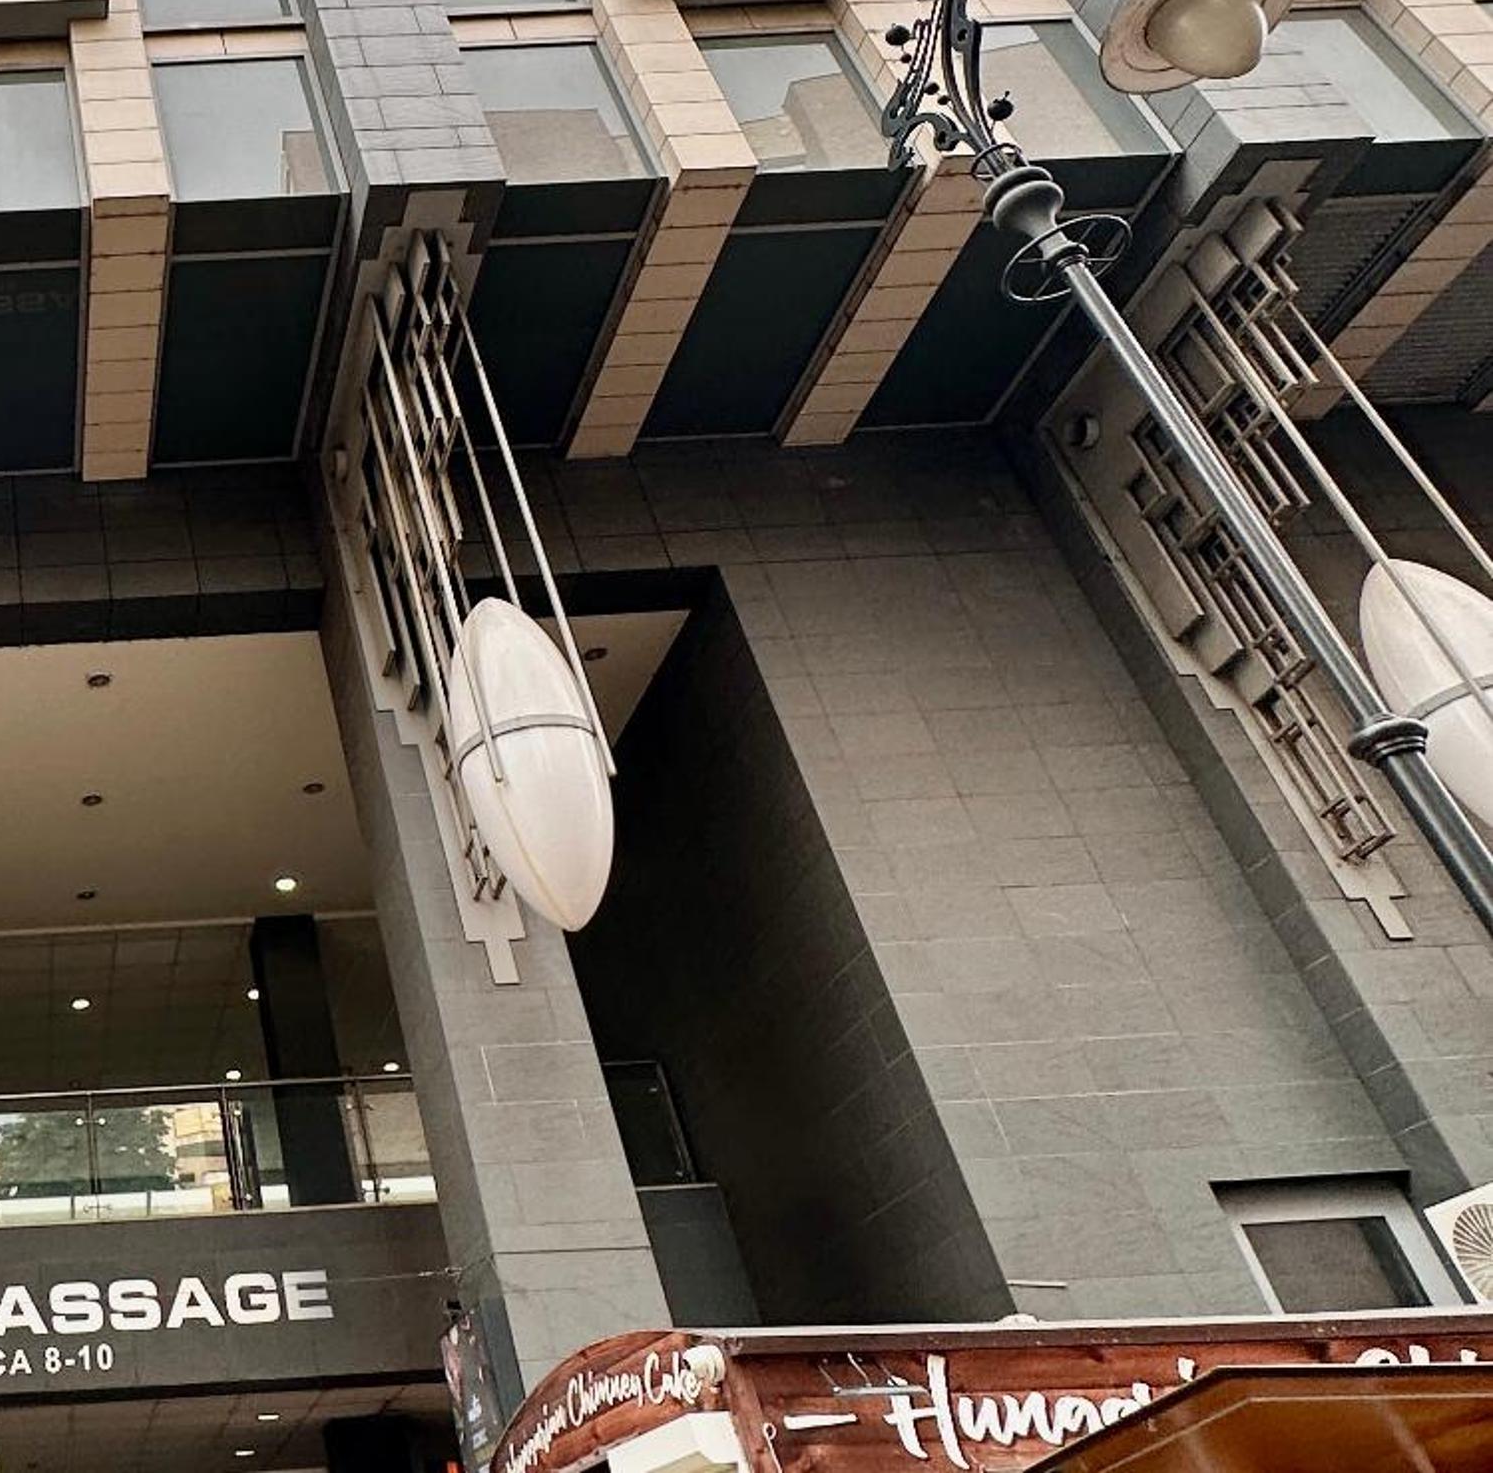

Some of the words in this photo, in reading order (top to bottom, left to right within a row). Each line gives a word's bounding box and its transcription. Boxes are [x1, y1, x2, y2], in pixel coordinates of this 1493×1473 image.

[43, 1343, 115, 1374] 8-10
[567, 1370, 644, 1427] Chimney
[644, 1351, 703, 1406] Cake
[883, 1354, 1195, 1470] Hunga
